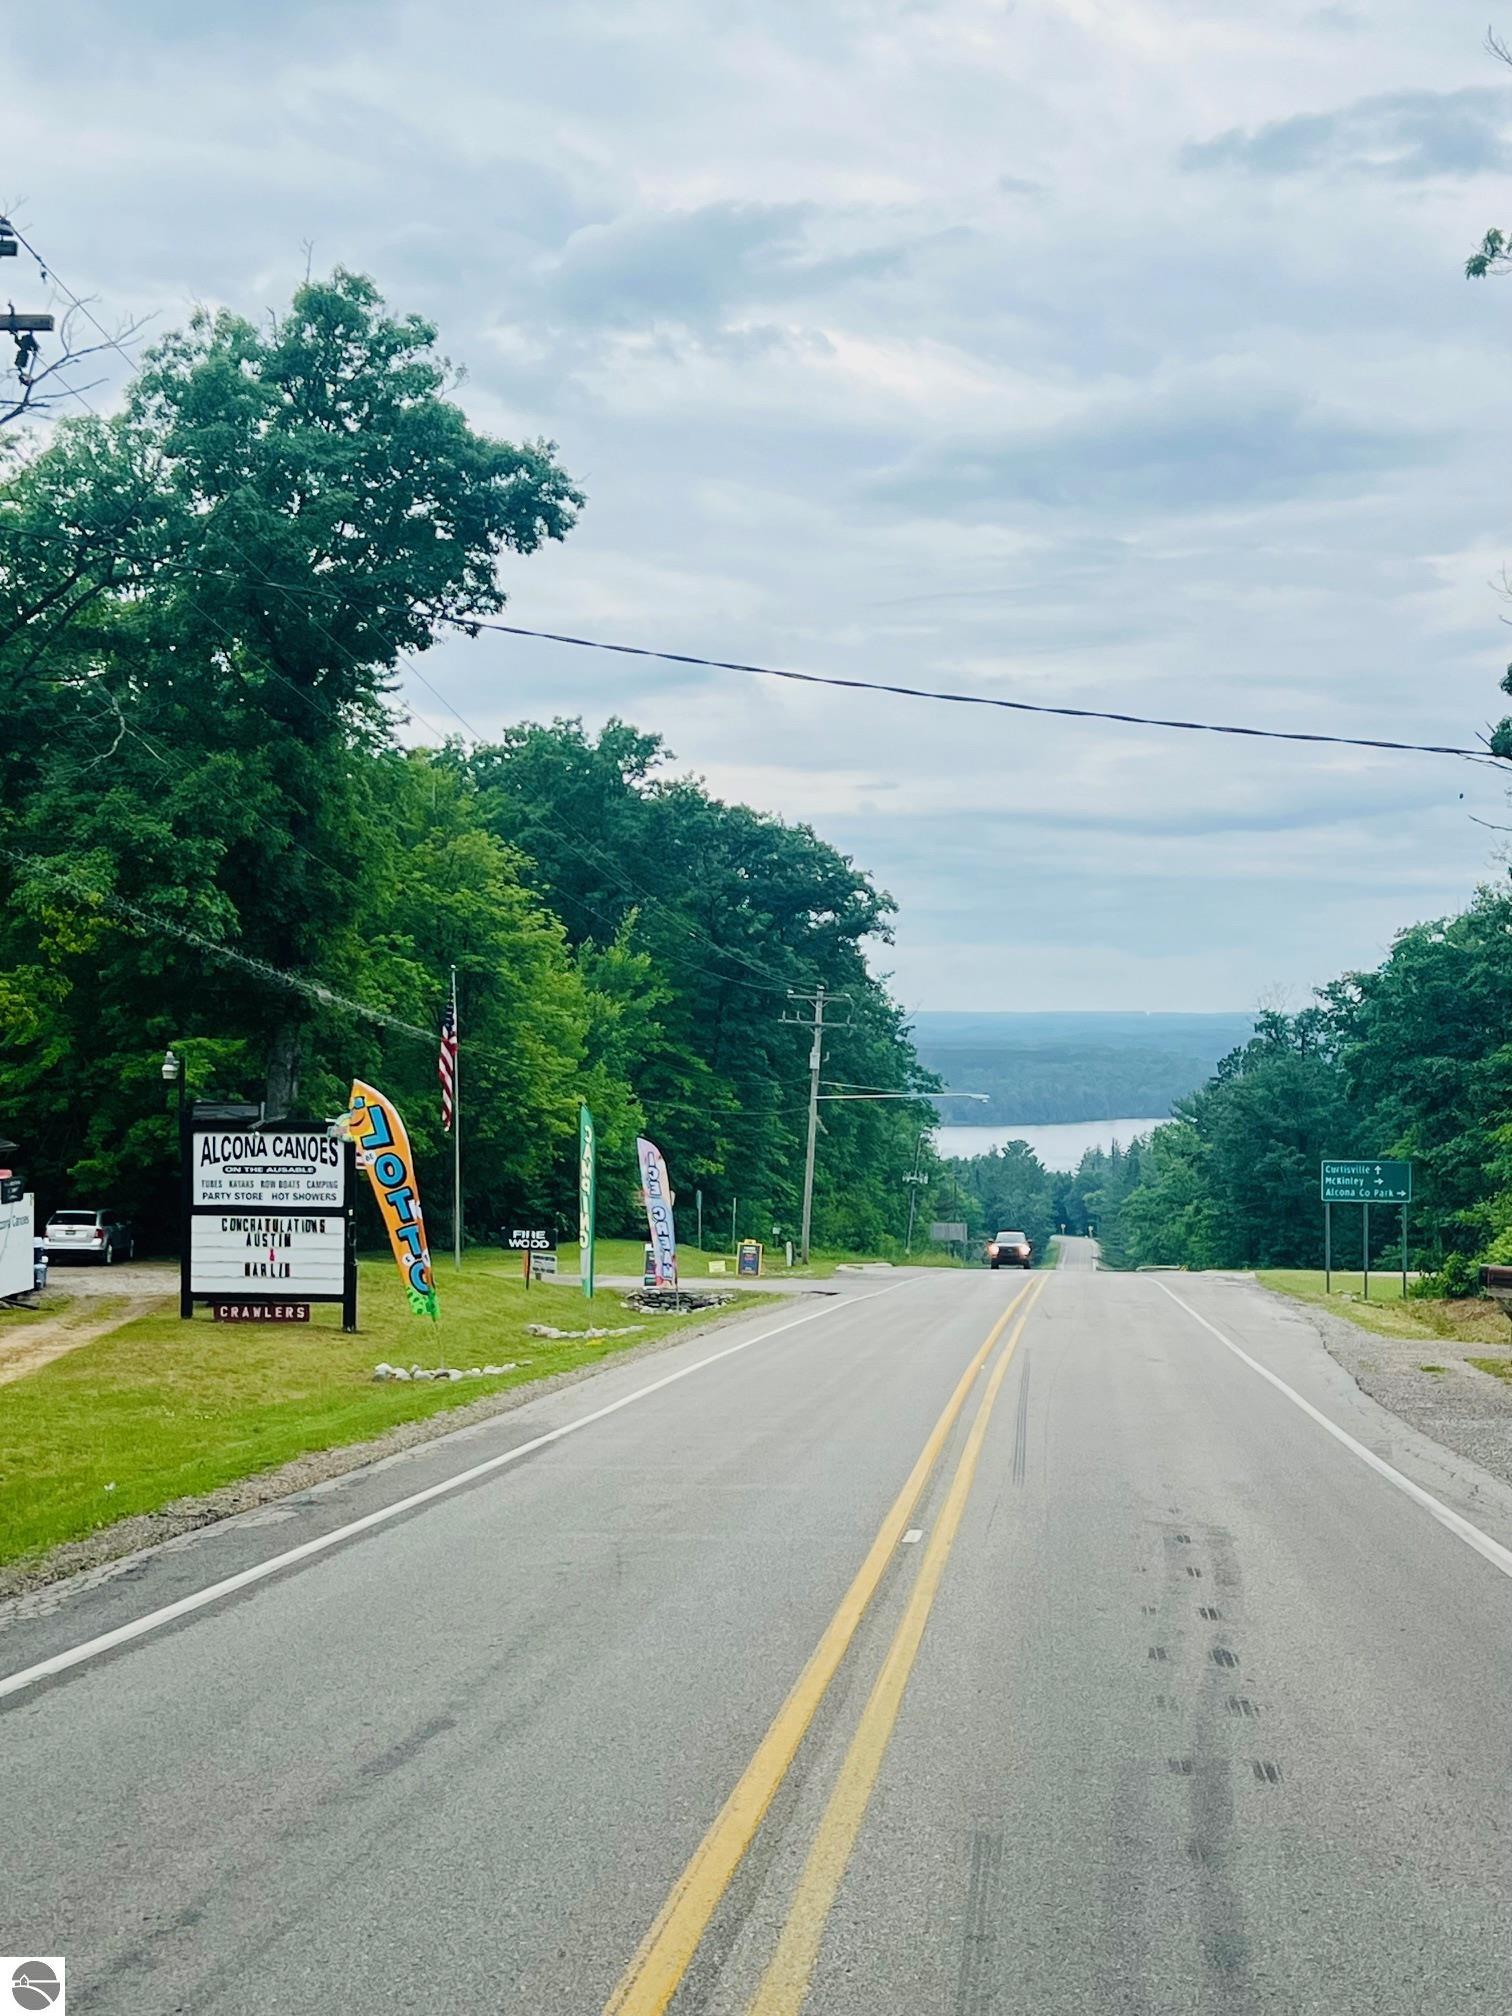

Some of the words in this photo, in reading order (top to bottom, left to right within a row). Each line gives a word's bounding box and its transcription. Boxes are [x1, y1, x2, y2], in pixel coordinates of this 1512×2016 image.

[200, 1135, 268, 1167] ALCONA
[272, 1136, 339, 1167] CANOES
[1325, 1165, 1370, 1174] Curtisville
[201, 1180, 222, 1188] TUBES
[229, 1180, 254, 1188] KAYAKS
[278, 1180, 300, 1188] BOATS
[306, 1180, 338, 1189] CAMPING
[1325, 1177, 1364, 1187] McKinley
[202, 1192, 231, 1200] PARTY
[234, 1192, 263, 1200] STORE
[271, 1192, 291, 1200] HOT
[293, 1192, 337, 1201] SHOWERS
[1325, 1188, 1356, 1197] Alcona
[1358, 1188, 1371, 1197] Co
[1373, 1189, 1394, 1198] Park
[246, 1233, 291, 1247] AUSTIN
[508, 1239, 550, 1249] WOOD
[220, 1305, 305, 1318] CRAWLERS
